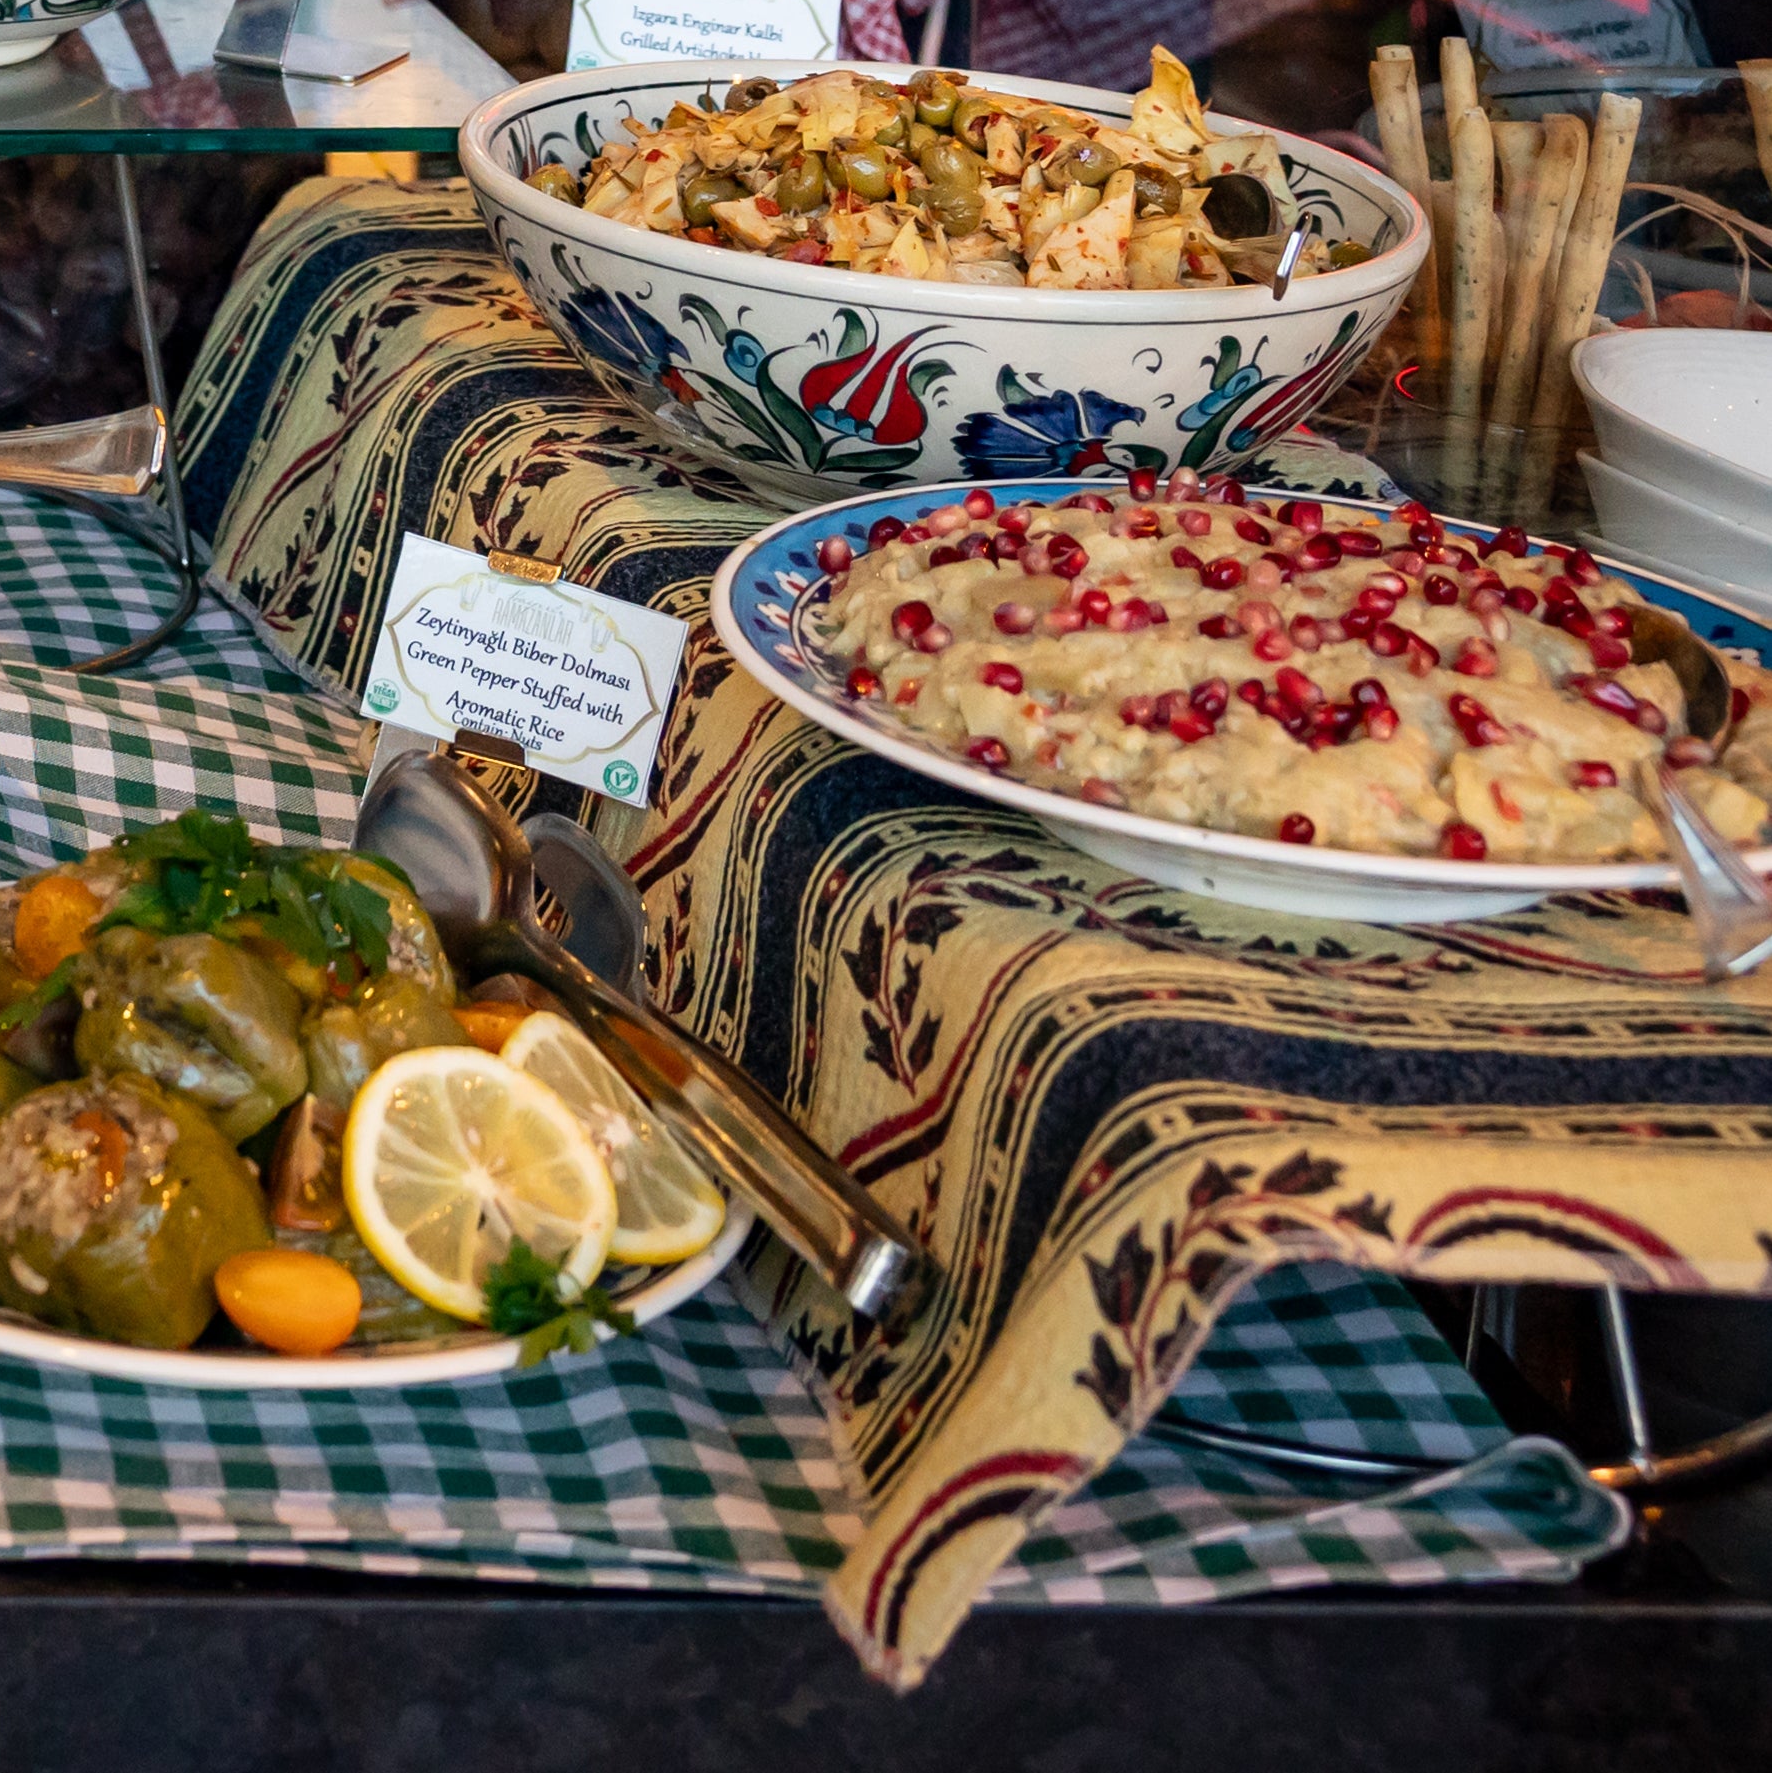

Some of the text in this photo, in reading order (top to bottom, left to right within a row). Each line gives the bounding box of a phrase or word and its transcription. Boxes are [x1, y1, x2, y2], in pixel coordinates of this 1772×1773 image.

[620, 31, 670, 52] Grilled
[682, 13, 741, 36] Enginar
[745, 23, 783, 42] Kalbi
[416, 607, 631, 691] Zeytinyağlı Biber Dolması
[407, 640, 624, 725] Green Pepper Stuffed with
[445, 690, 565, 743] Aromatic Rice
[511, 730, 543, 752] Nuts
